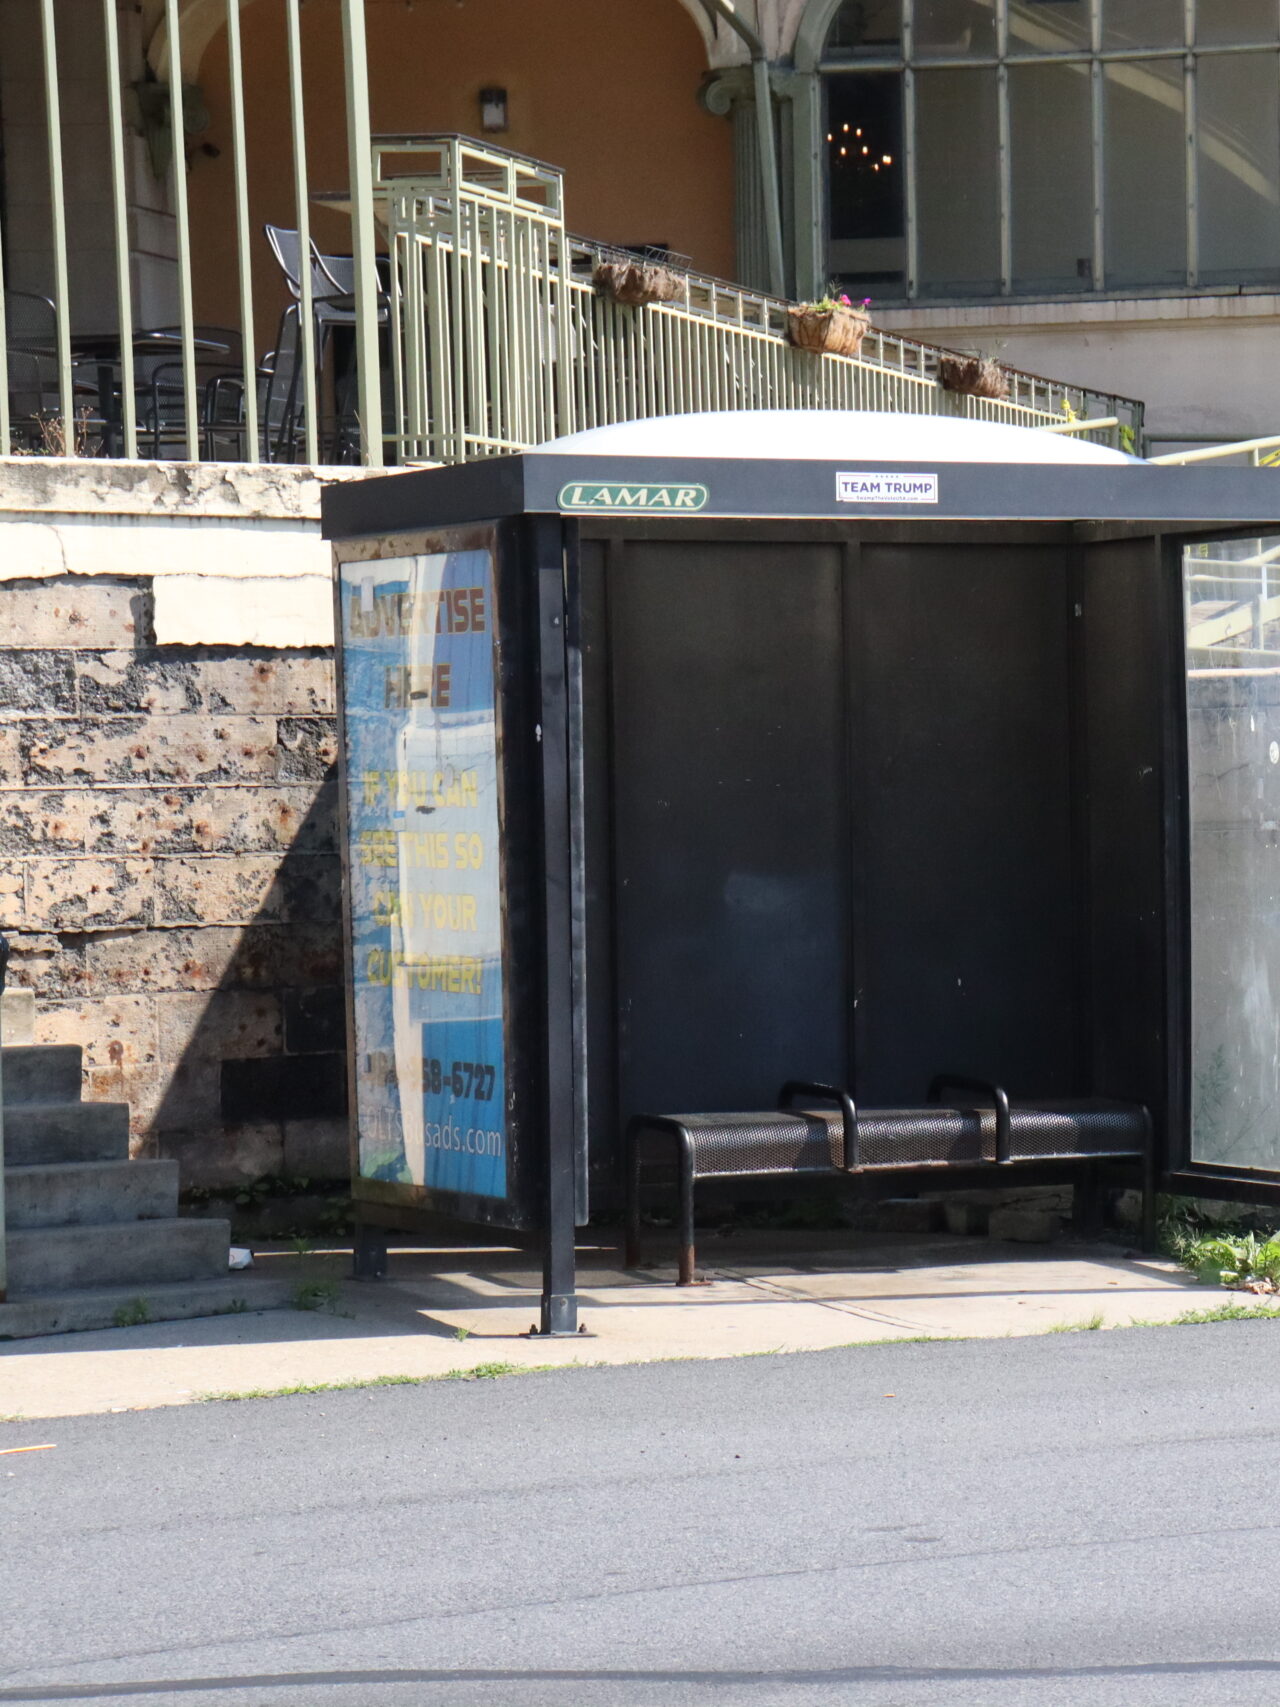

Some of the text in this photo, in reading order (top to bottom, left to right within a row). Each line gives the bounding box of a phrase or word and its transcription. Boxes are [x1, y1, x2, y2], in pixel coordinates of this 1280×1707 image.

[571, 486, 697, 507] LAMAR
[841, 482, 933, 494] TEAM TRUMP
[384, 770, 427, 809] YOU
[401, 832, 449, 869] THIS
[455, 832, 484, 870] SO
[419, 892, 478, 932] YOUR
